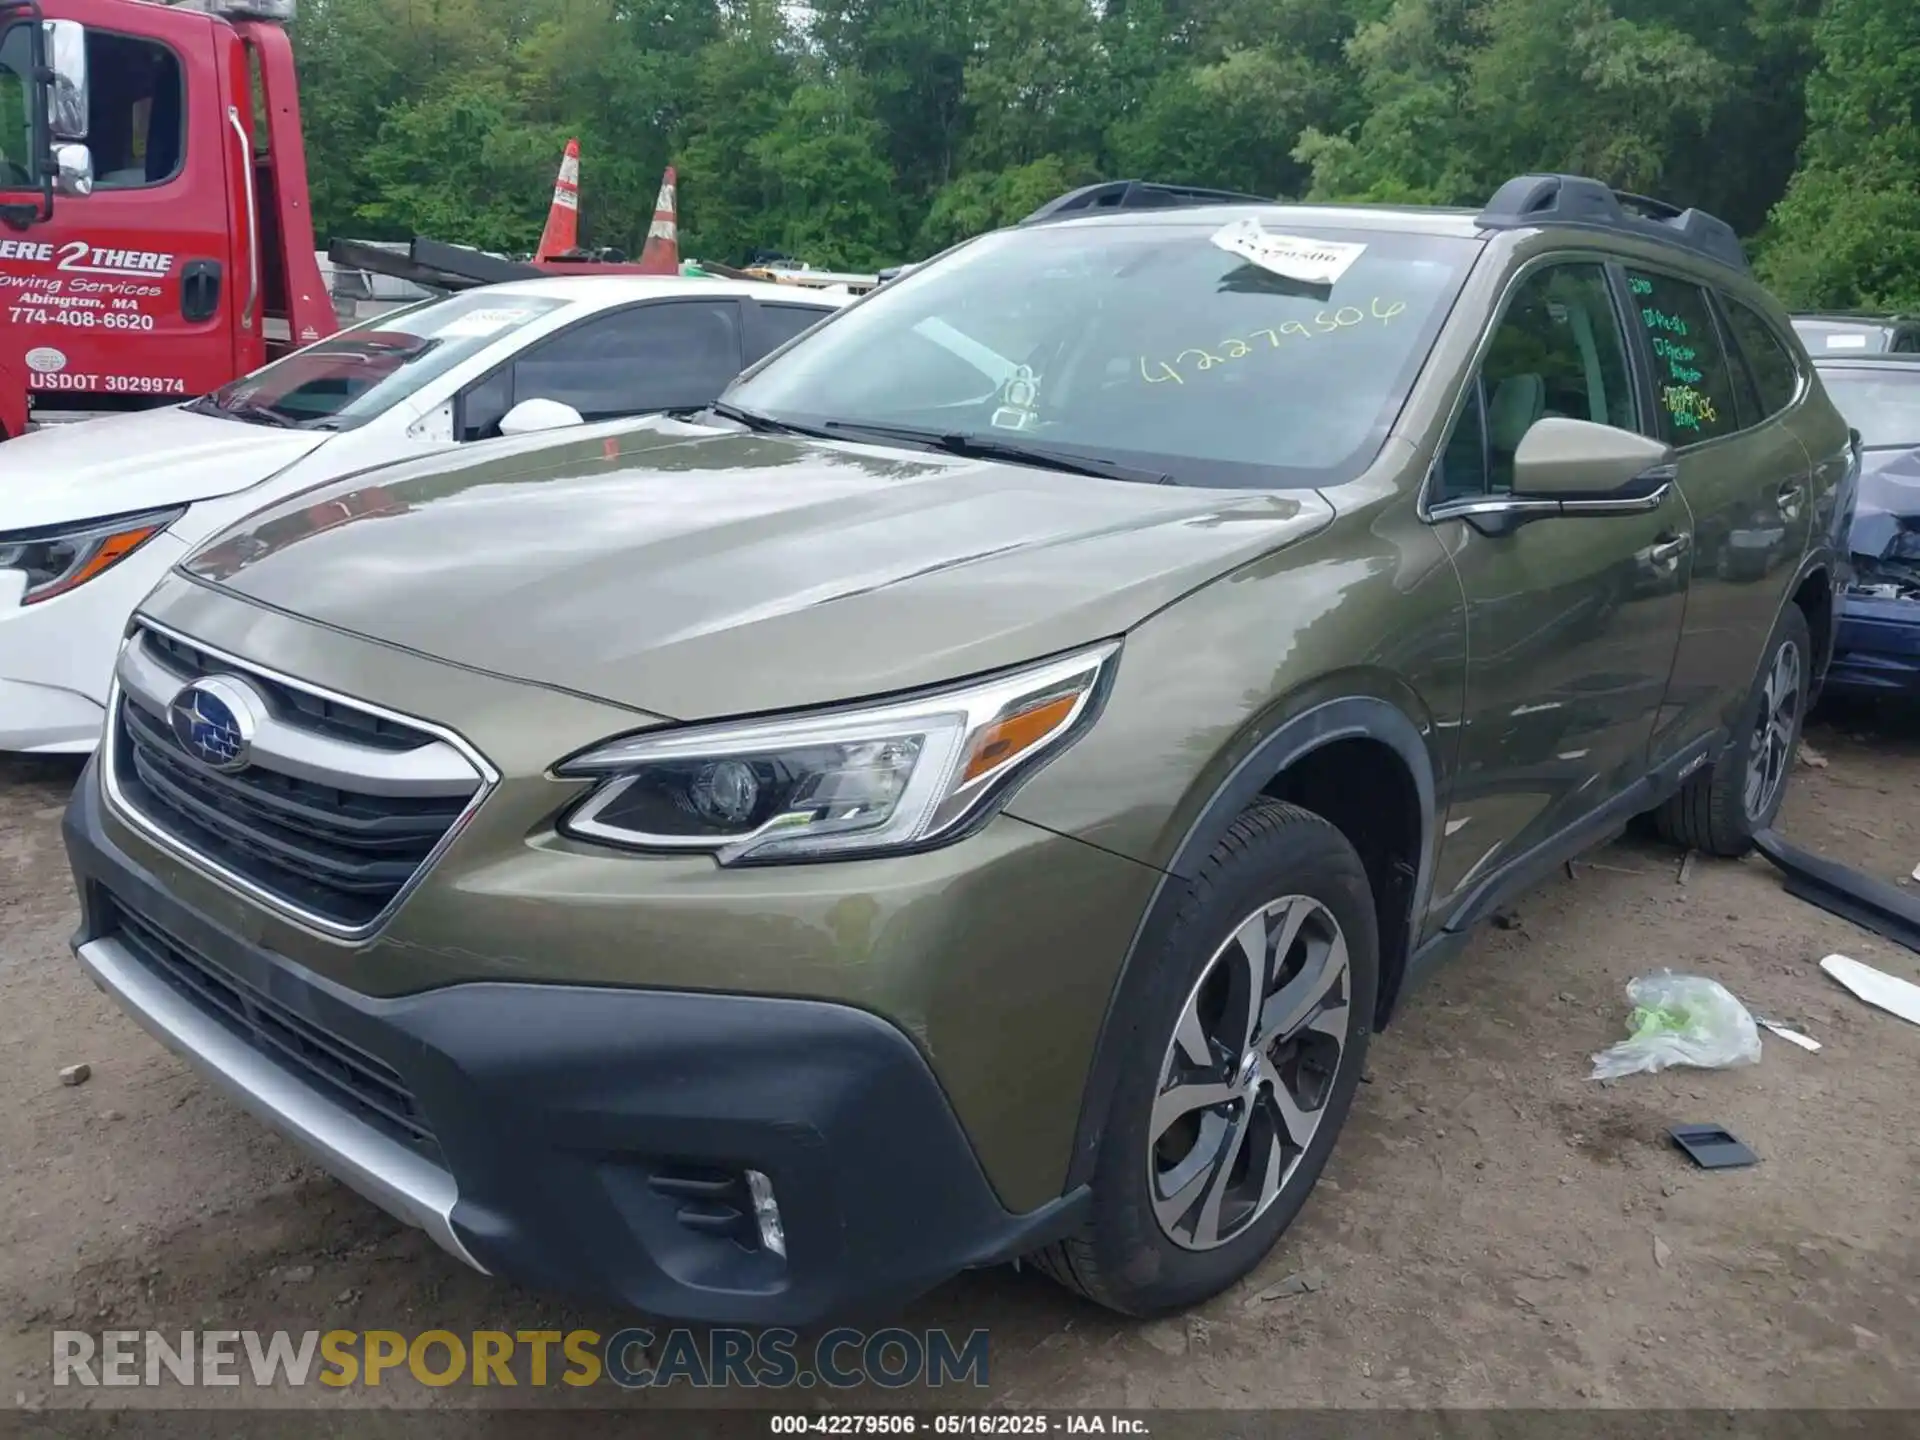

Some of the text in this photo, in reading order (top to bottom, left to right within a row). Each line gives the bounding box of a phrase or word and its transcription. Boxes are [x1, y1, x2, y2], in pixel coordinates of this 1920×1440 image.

[0, 240, 174, 271] ERE 2 THERE
[0, 272, 163, 296] owing Services
[19, 292, 139, 310] Abington, MA
[9, 307, 154, 330] 774-408-6620
[1140, 297, 1406, 385] 42279506
[30, 373, 184, 393] USDOT 3029974
